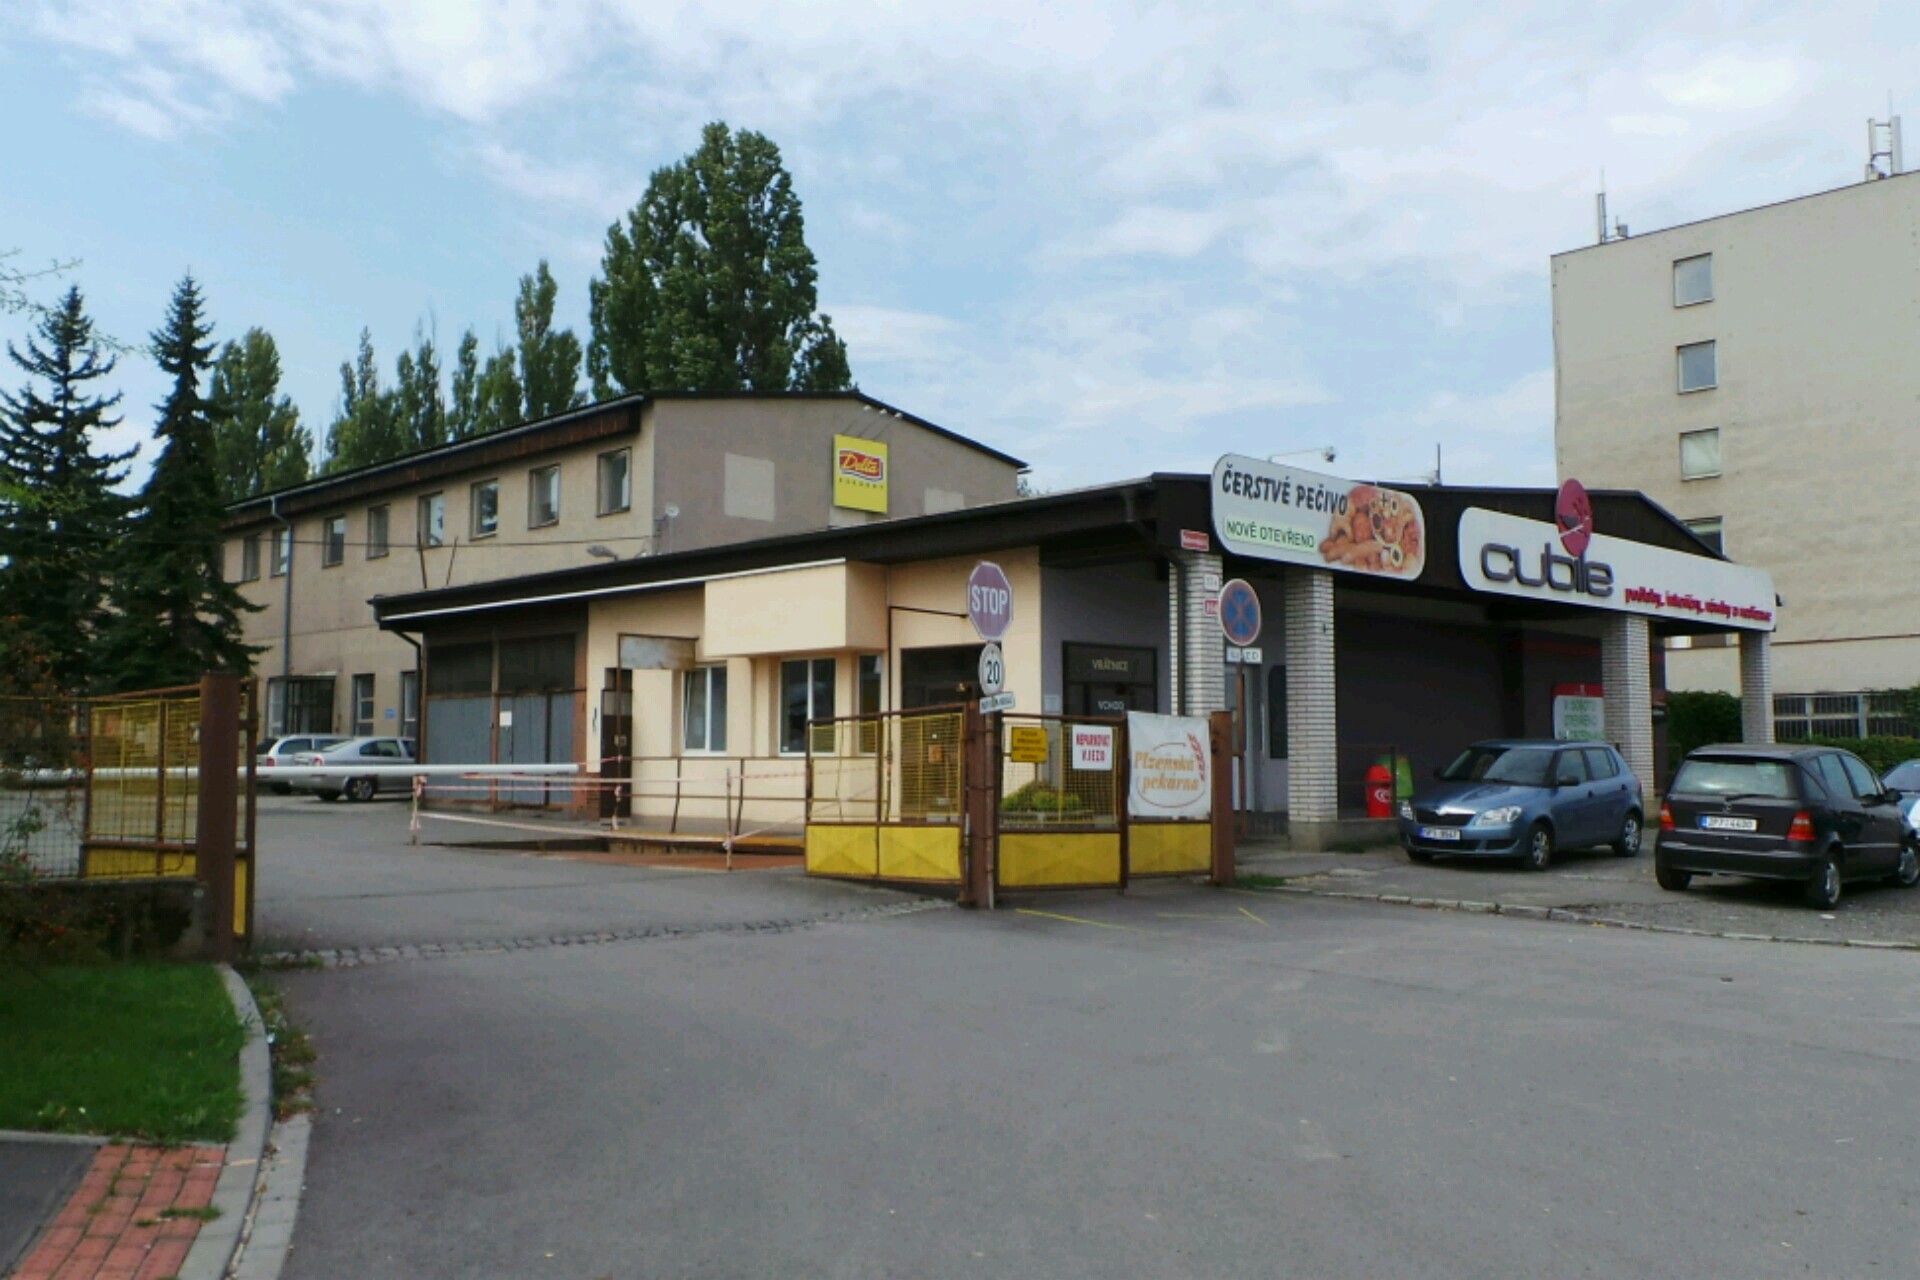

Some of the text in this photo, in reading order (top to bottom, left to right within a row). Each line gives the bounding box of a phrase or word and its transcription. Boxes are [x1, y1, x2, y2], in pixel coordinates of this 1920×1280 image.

[840, 452, 878, 474] Delta
[1221, 463, 1348, 516] ČERSTVÉ PEČIVO
[1226, 517, 1315, 549] NOVÉ OTEVŘENO
[971, 585, 1008, 616] STOP
[986, 659, 1000, 685] 20
